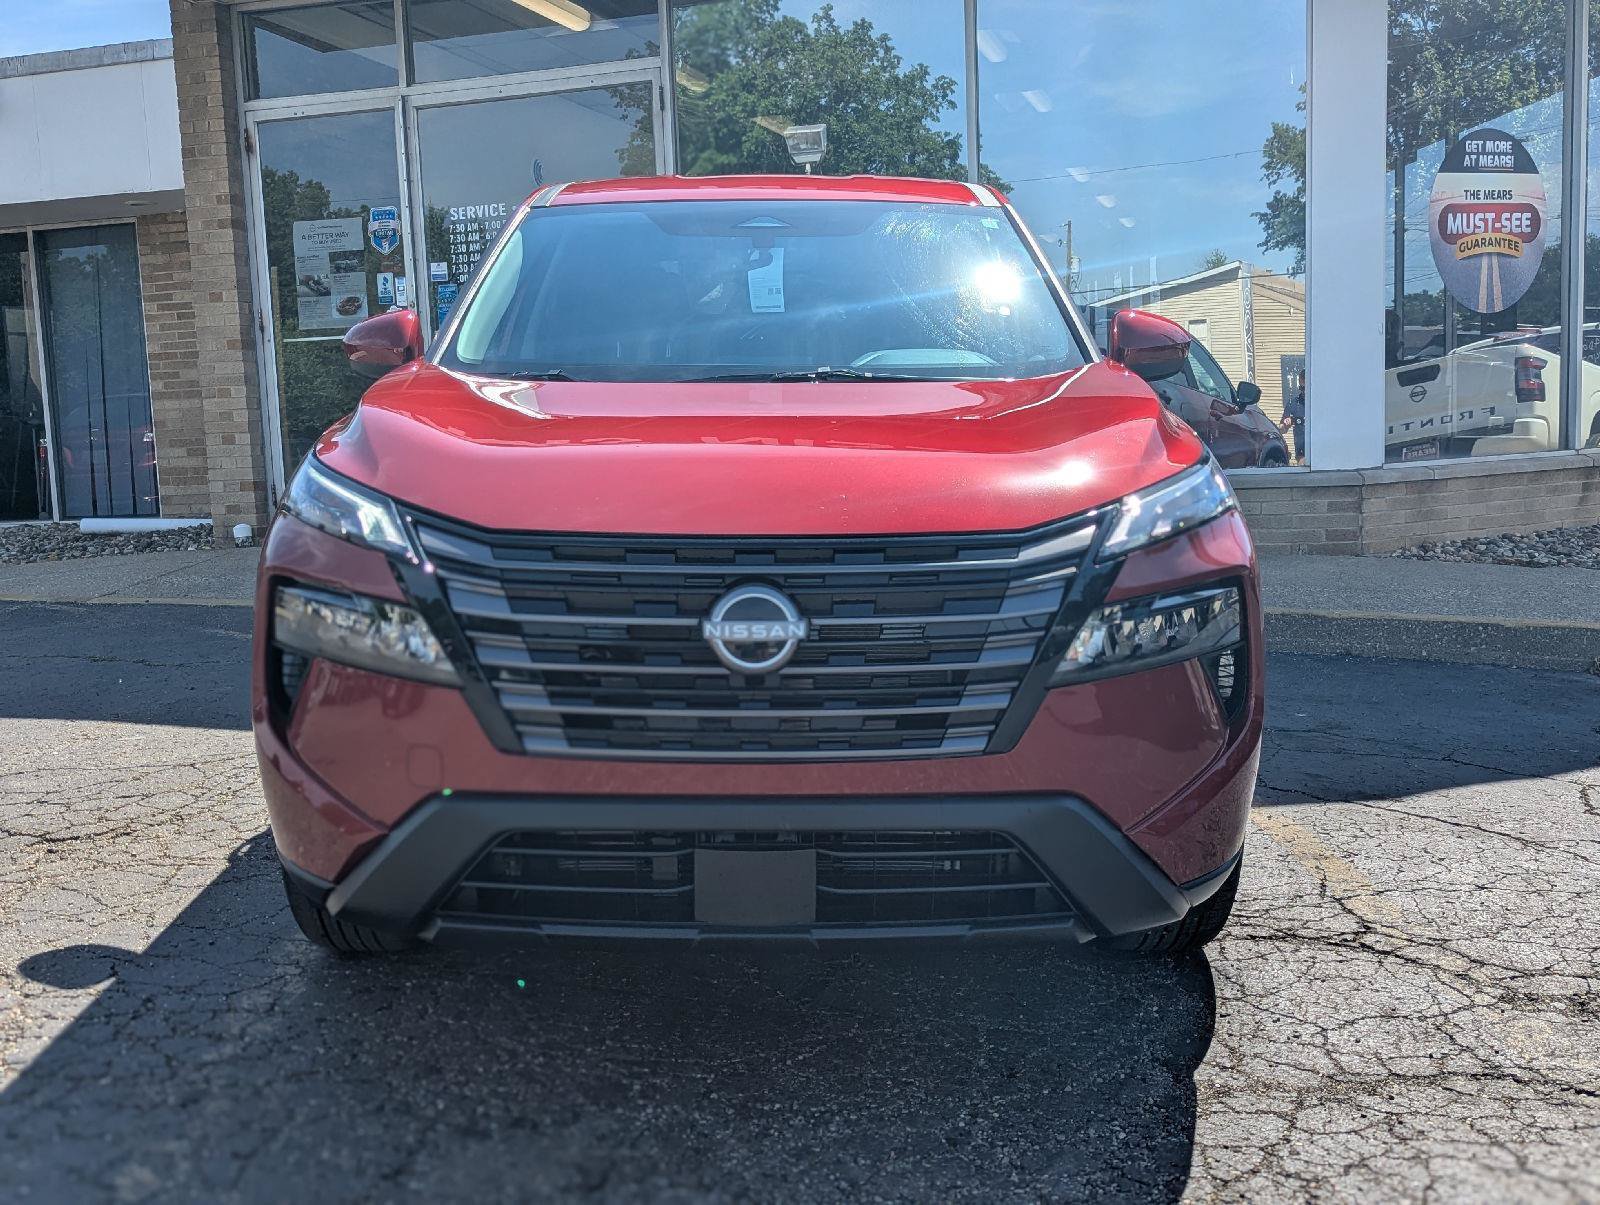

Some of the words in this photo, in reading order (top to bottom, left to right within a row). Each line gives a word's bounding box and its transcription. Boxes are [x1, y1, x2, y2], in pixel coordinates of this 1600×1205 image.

[1466, 141, 1483, 153] GET
[1486, 141, 1513, 153] MORE
[1464, 155, 1477, 167] AT
[1479, 155, 1515, 168] MEARS!
[1464, 190, 1481, 200] THE
[1484, 190, 1513, 200] MEARS
[450, 203, 507, 220] SERVICE
[449, 224, 465, 233] 7:30
[467, 223, 479, 232] AM
[1447, 213, 1532, 234] MUST-SEE
[308, 232, 334, 241] BETTER
[335, 231, 350, 239] WAY
[449, 234, 466, 243] 7:30
[468, 233, 480, 241] AM
[450, 244, 467, 254] 7:30
[469, 243, 481, 252] AM
[1459, 237, 1520, 253] GUARANTEE
[452, 254, 468, 263] 7:30
[452, 264, 468, 273] 7:30
[703, 622, 805, 639] NISSAN
